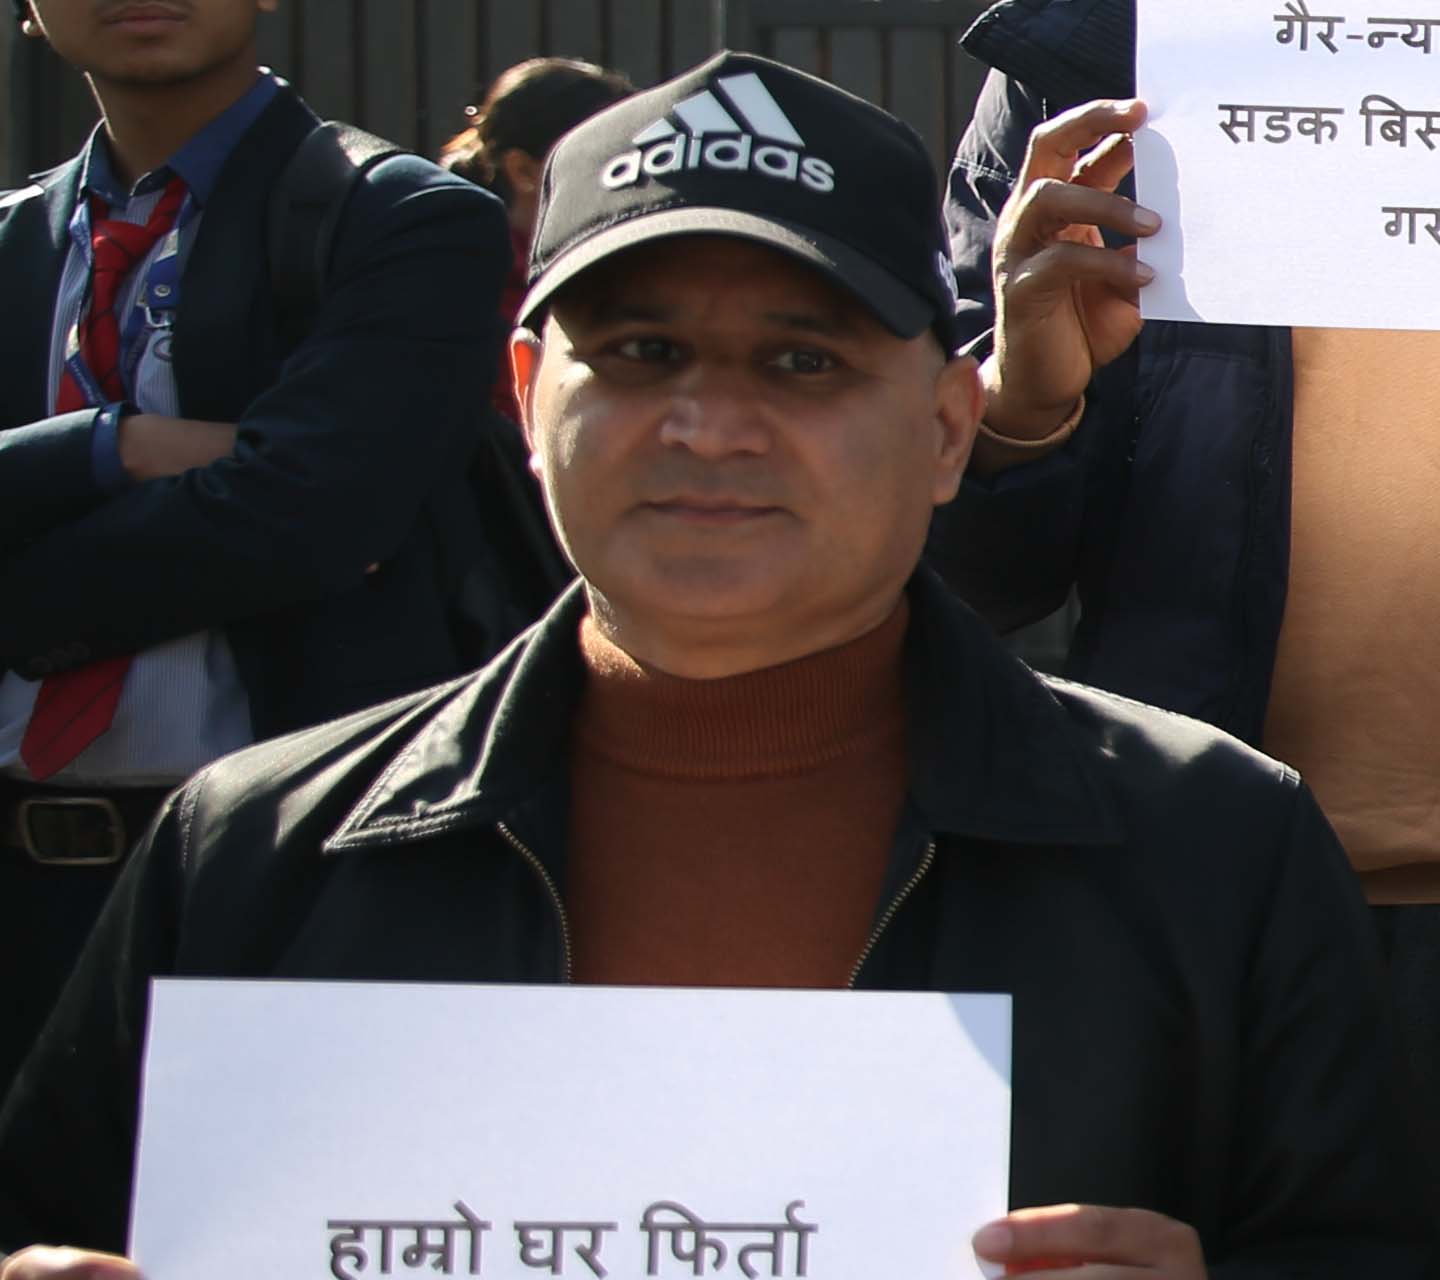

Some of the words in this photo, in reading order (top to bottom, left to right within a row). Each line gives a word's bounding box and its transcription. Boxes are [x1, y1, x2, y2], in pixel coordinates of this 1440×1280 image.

[1218, 104, 1344, 144] सडक
[602, 133, 835, 193] adidas
[513, 1222, 617, 1279] घर
[640, 1201, 817, 1280] फिर्ता
